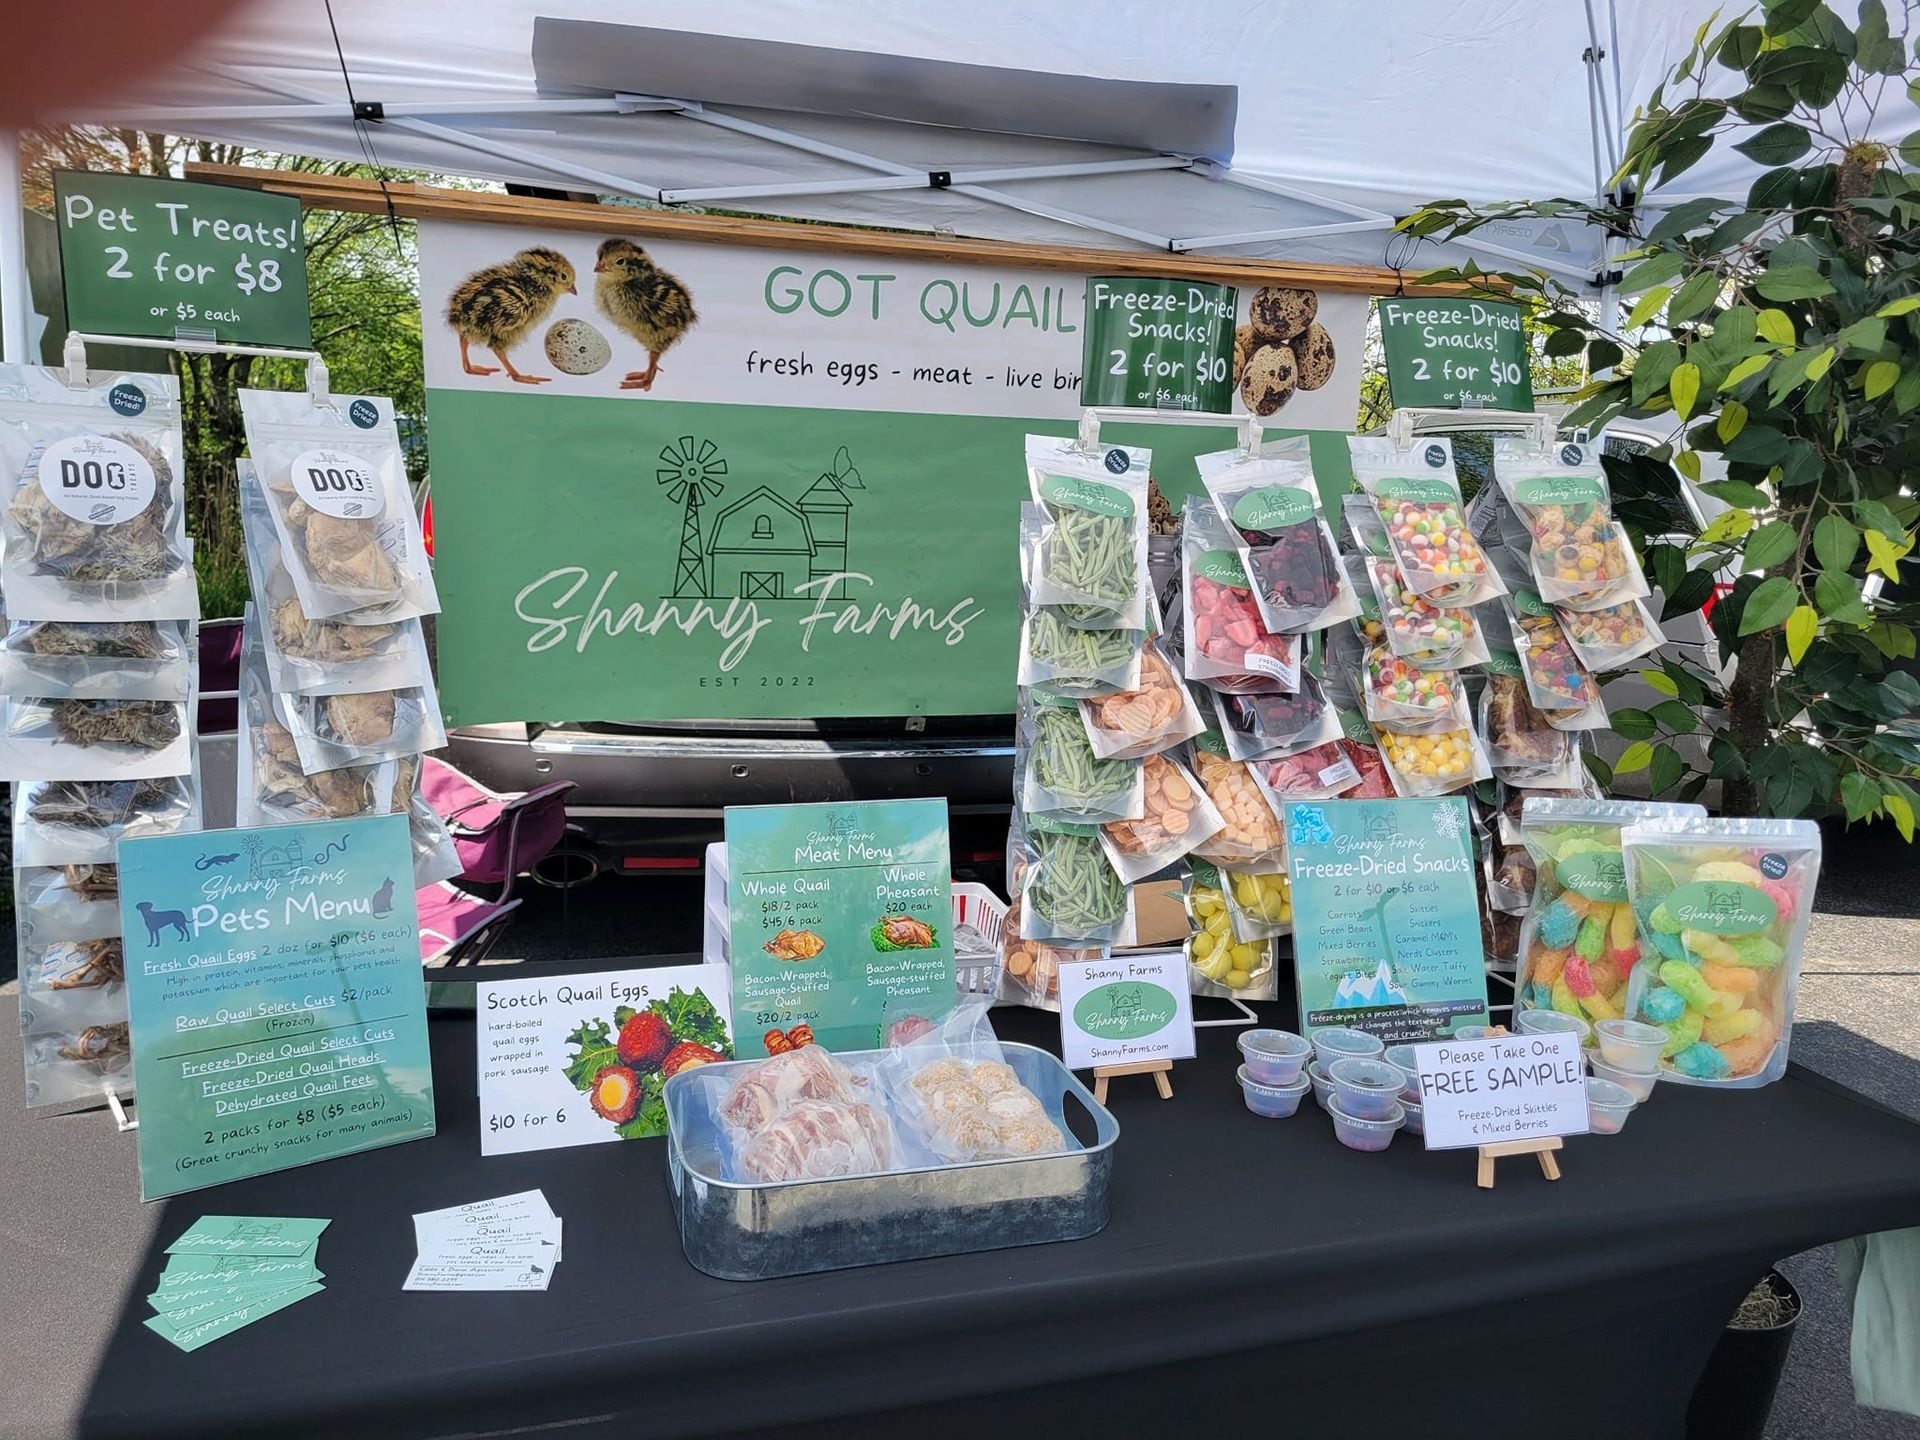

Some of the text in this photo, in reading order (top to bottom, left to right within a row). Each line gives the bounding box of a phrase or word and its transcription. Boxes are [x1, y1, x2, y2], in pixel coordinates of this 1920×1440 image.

[65, 195, 297, 253] Pet Treats!
[105, 246, 282, 295] 2 for $8
[764, 266, 1086, 333] GOT QUAIL
[1094, 284, 1235, 320] Freeze-Dried
[150, 302, 241, 322] or $5 each
[1386, 304, 1520, 332] Freeze-Dried
[1128, 313, 1213, 345] Snacks!
[1423, 327, 1499, 353] Snacks!
[746, 350, 1043, 388] fresh eggs meat live
[1109, 350, 1226, 386] 2 for $10
[1411, 357, 1521, 387] 2 for $10
[114, 389, 143, 403] Freeze
[1156, 387, 1171, 401] $6
[114, 398, 140, 411] Dried!
[354, 402, 377, 420] Freeze
[61, 459, 126, 490] DOG
[307, 468, 364, 491] DOG
[514, 566, 985, 672] Shanny Farms
[700, 676, 816, 688] EST 2022
[794, 842, 893, 864] Meat Menu
[883, 867, 927, 883] Whole
[1294, 852, 1471, 879] Freeze-Dried Snacks
[201, 866, 349, 901] Shanny Farms
[741, 877, 830, 896] Whole Quail
[876, 884, 940, 900] Pheasant
[1334, 879, 1441, 897] 2 for $10 $6 each
[1567, 874, 1614, 894] Shanny
[191, 893, 372, 937] Pets Menu
[761, 900, 819, 914] $18/2 pack
[885, 901, 933, 914] $20 each
[1327, 910, 1362, 921] Carrots
[1678, 906, 1727, 926] Shanny
[762, 915, 823, 929] $45/6 pack
[1319, 924, 1373, 936] Green Beans
[144, 924, 413, 973] Fresh Quail Eggs 2 doz for $10 each)
[1346, 939, 1377, 949] Berries
[1395, 934, 1428, 945] Caramel
[1321, 954, 1377, 967] Strawberries
[1397, 947, 1459, 960] Nerds Clusters
[1085, 964, 1163, 980] Shanny Farms
[1323, 968, 1377, 982] Yogurt Bites
[1411, 961, 1467, 974] Water Taffy
[162, 972, 308, 1001] potassium which important
[744, 969, 829, 986] Bacon-Wrapped,
[867, 971, 946, 987] Sausage-stuffed
[1443, 975, 1473, 986] Worms
[487, 981, 649, 1010] Scotch Quail Eggs
[744, 982, 830, 998] Sausage-Stuffed
[886, 984, 932, 997] Pheasant
[176, 985, 393, 1030] Raw Quail Select Cuts $2/pack
[775, 995, 802, 1009] Quail
[265, 1013, 315, 1032] (Frozen)
[488, 1017, 543, 1031] hard-boiled
[756, 1010, 820, 1026] $20/2 pack
[1310, 1012, 1357, 1024] Freeze-drying
[492, 1034, 540, 1048] quail eggs
[1091, 1043, 1169, 1058] ShannyFarms.com
[181, 1028, 395, 1075] Freeze-Dried Quail Select Cuts
[489, 1051, 532, 1063] wrapped
[1439, 1040, 1560, 1065] Please Take One
[202, 1052, 380, 1095] Freeze-Dried Quail Heads
[484, 1064, 550, 1080] pork sausage
[1420, 1060, 1583, 1097] FREE SAMPLE!
[215, 1074, 372, 1113] Dehydrated Quail Feet
[204, 1094, 386, 1143] 2 packs for $8 ($5 each)
[489, 1108, 567, 1133] $10 for 6
[1458, 1101, 1558, 1121] Freeze-Dried Skittles
[1482, 1119, 1549, 1134] Mixed Berries
[175, 1110, 413, 1172] (Great crunchy snacks for many animals)
